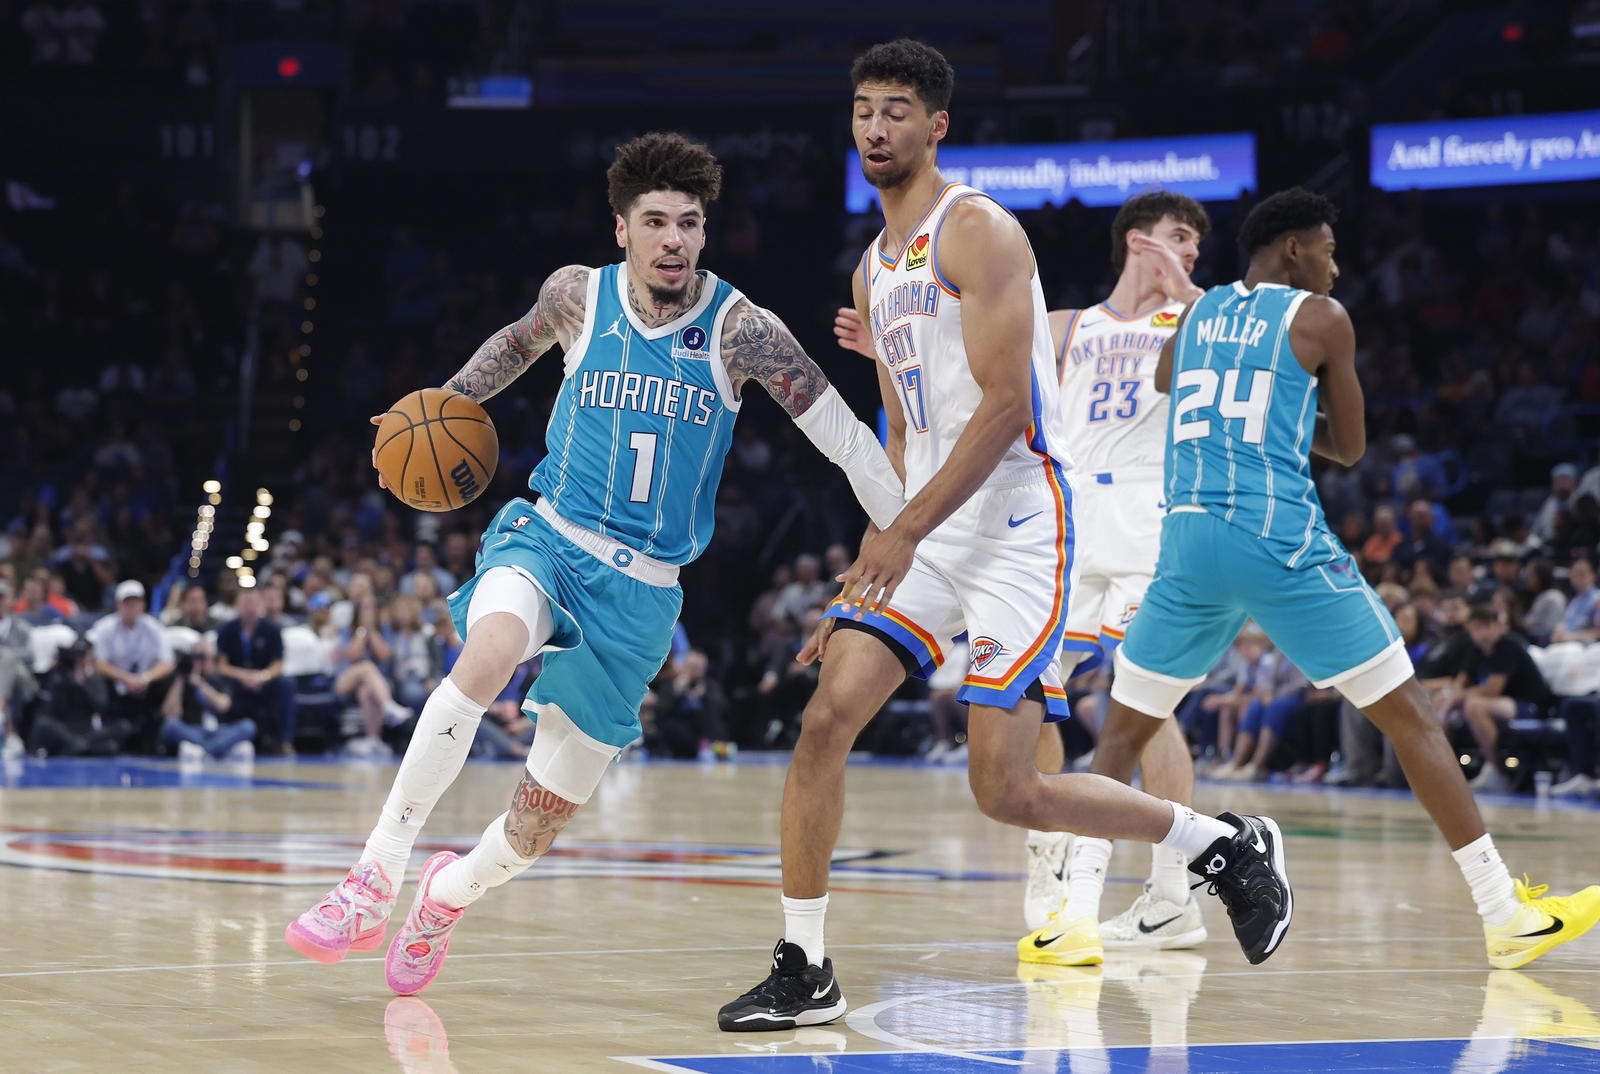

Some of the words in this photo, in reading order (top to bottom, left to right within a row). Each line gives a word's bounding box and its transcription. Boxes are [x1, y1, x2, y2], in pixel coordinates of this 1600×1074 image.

[1387, 140, 1441, 170] And
[1530, 137, 1575, 170] pro
[870, 281, 940, 341] KLAHOMA
[1196, 315, 1268, 347] MILLER
[881, 323, 917, 367] CITY
[1070, 331, 1167, 367] OKLAHOM
[1095, 354, 1145, 377] CITY
[578, 370, 716, 426] HORNETS
[896, 365, 928, 434] 17
[1088, 378, 1144, 424] 23
[1173, 368, 1273, 445] 24
[629, 432, 658, 503] 1
